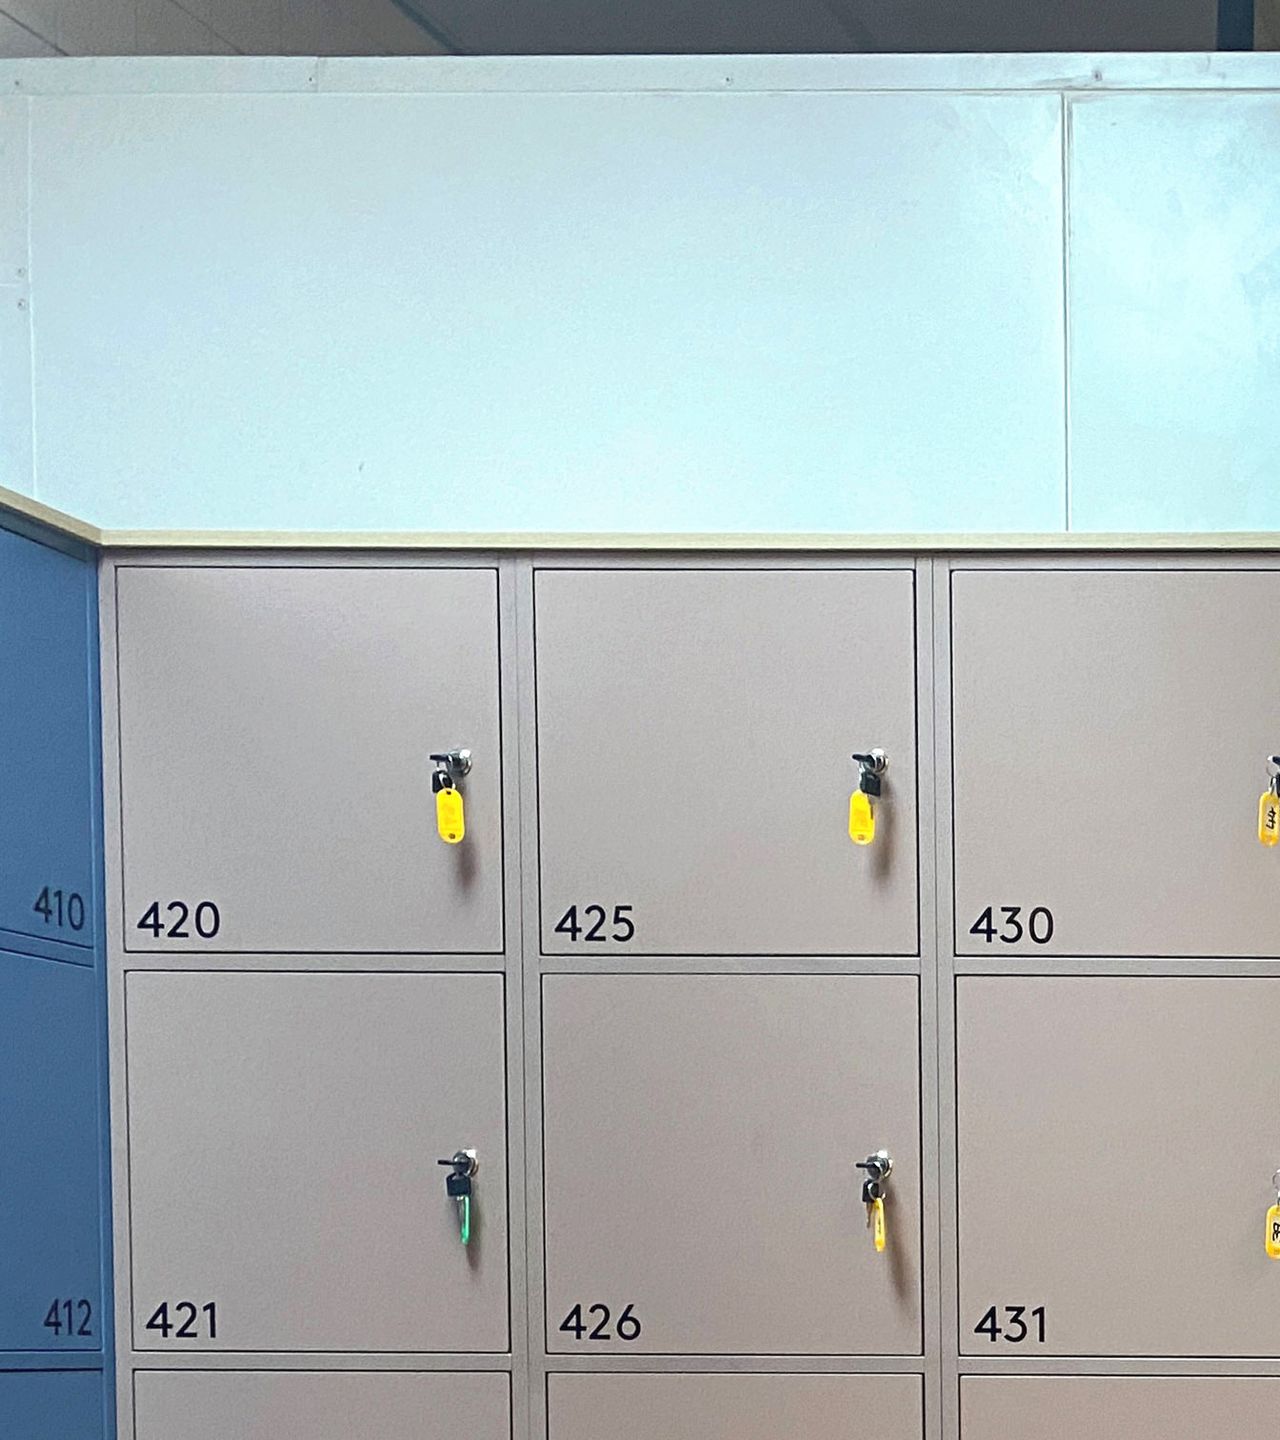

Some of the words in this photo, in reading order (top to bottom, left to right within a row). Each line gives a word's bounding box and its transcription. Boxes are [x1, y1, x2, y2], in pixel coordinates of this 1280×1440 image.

[33, 886, 85, 932] 410
[136, 900, 221, 939] 420
[554, 904, 635, 943] 425
[969, 906, 1054, 945] 430
[43, 1298, 92, 1336] 412
[145, 1301, 217, 1339] 421
[558, 1303, 642, 1341] 426
[973, 1305, 1046, 1343] 431
